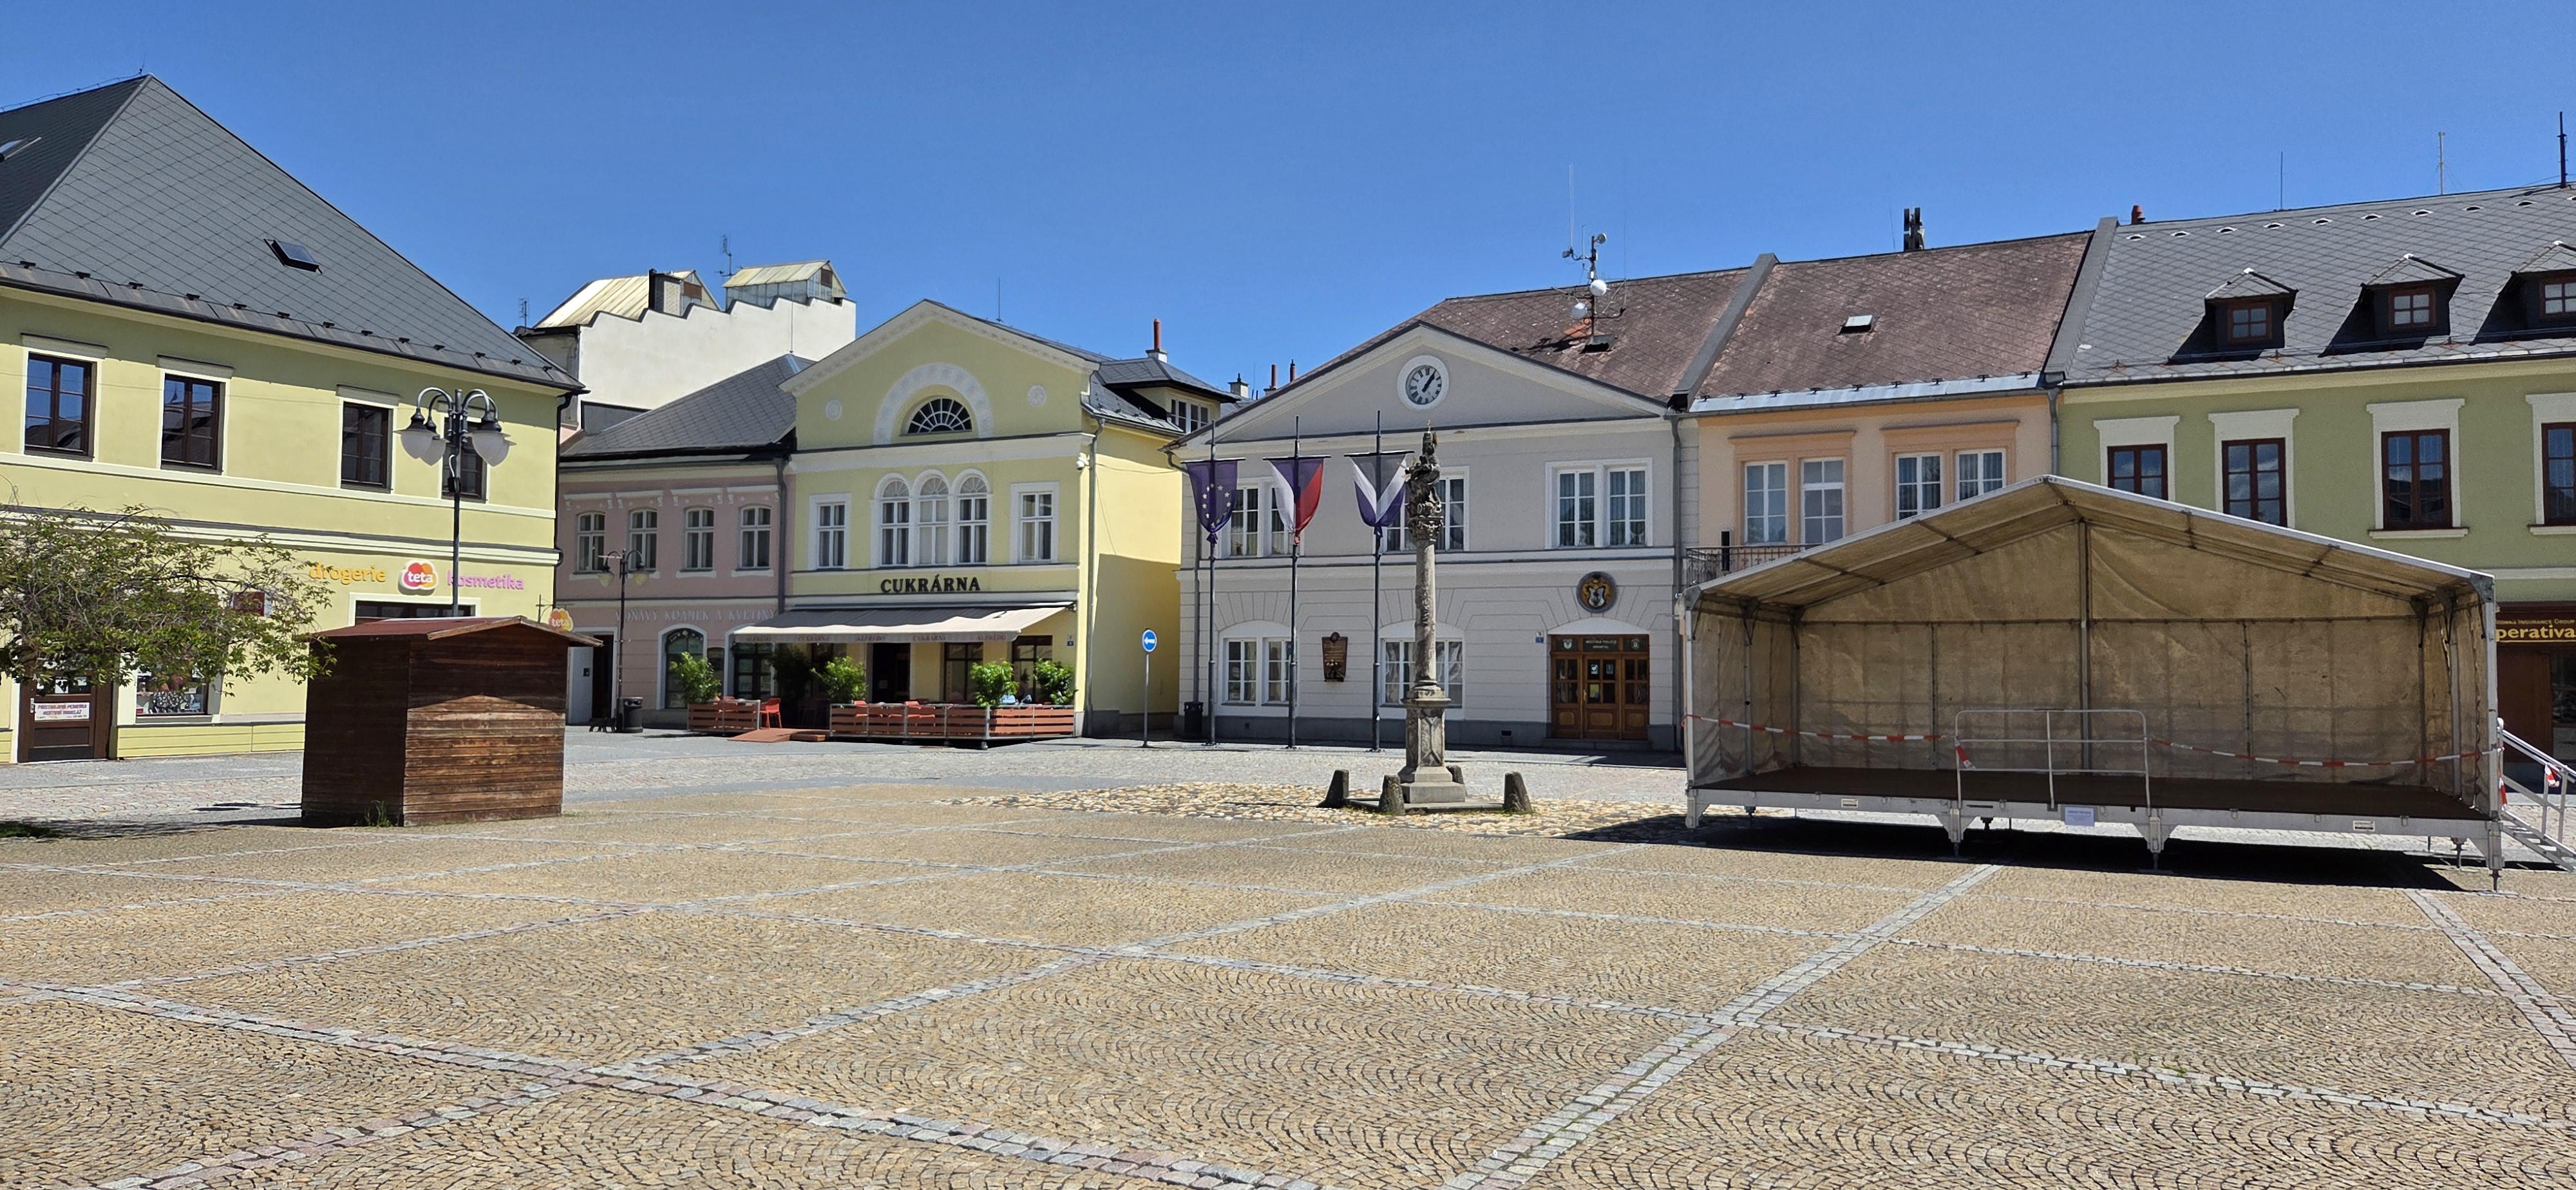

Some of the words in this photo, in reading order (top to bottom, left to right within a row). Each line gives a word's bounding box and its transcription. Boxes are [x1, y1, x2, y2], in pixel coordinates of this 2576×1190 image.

[309, 562, 386, 585] drogerie
[408, 571, 433, 583] teta
[880, 574, 981, 593] CUKRÁRNA
[551, 618, 569, 627] teta
[2496, 625, 2576, 642] perativa
